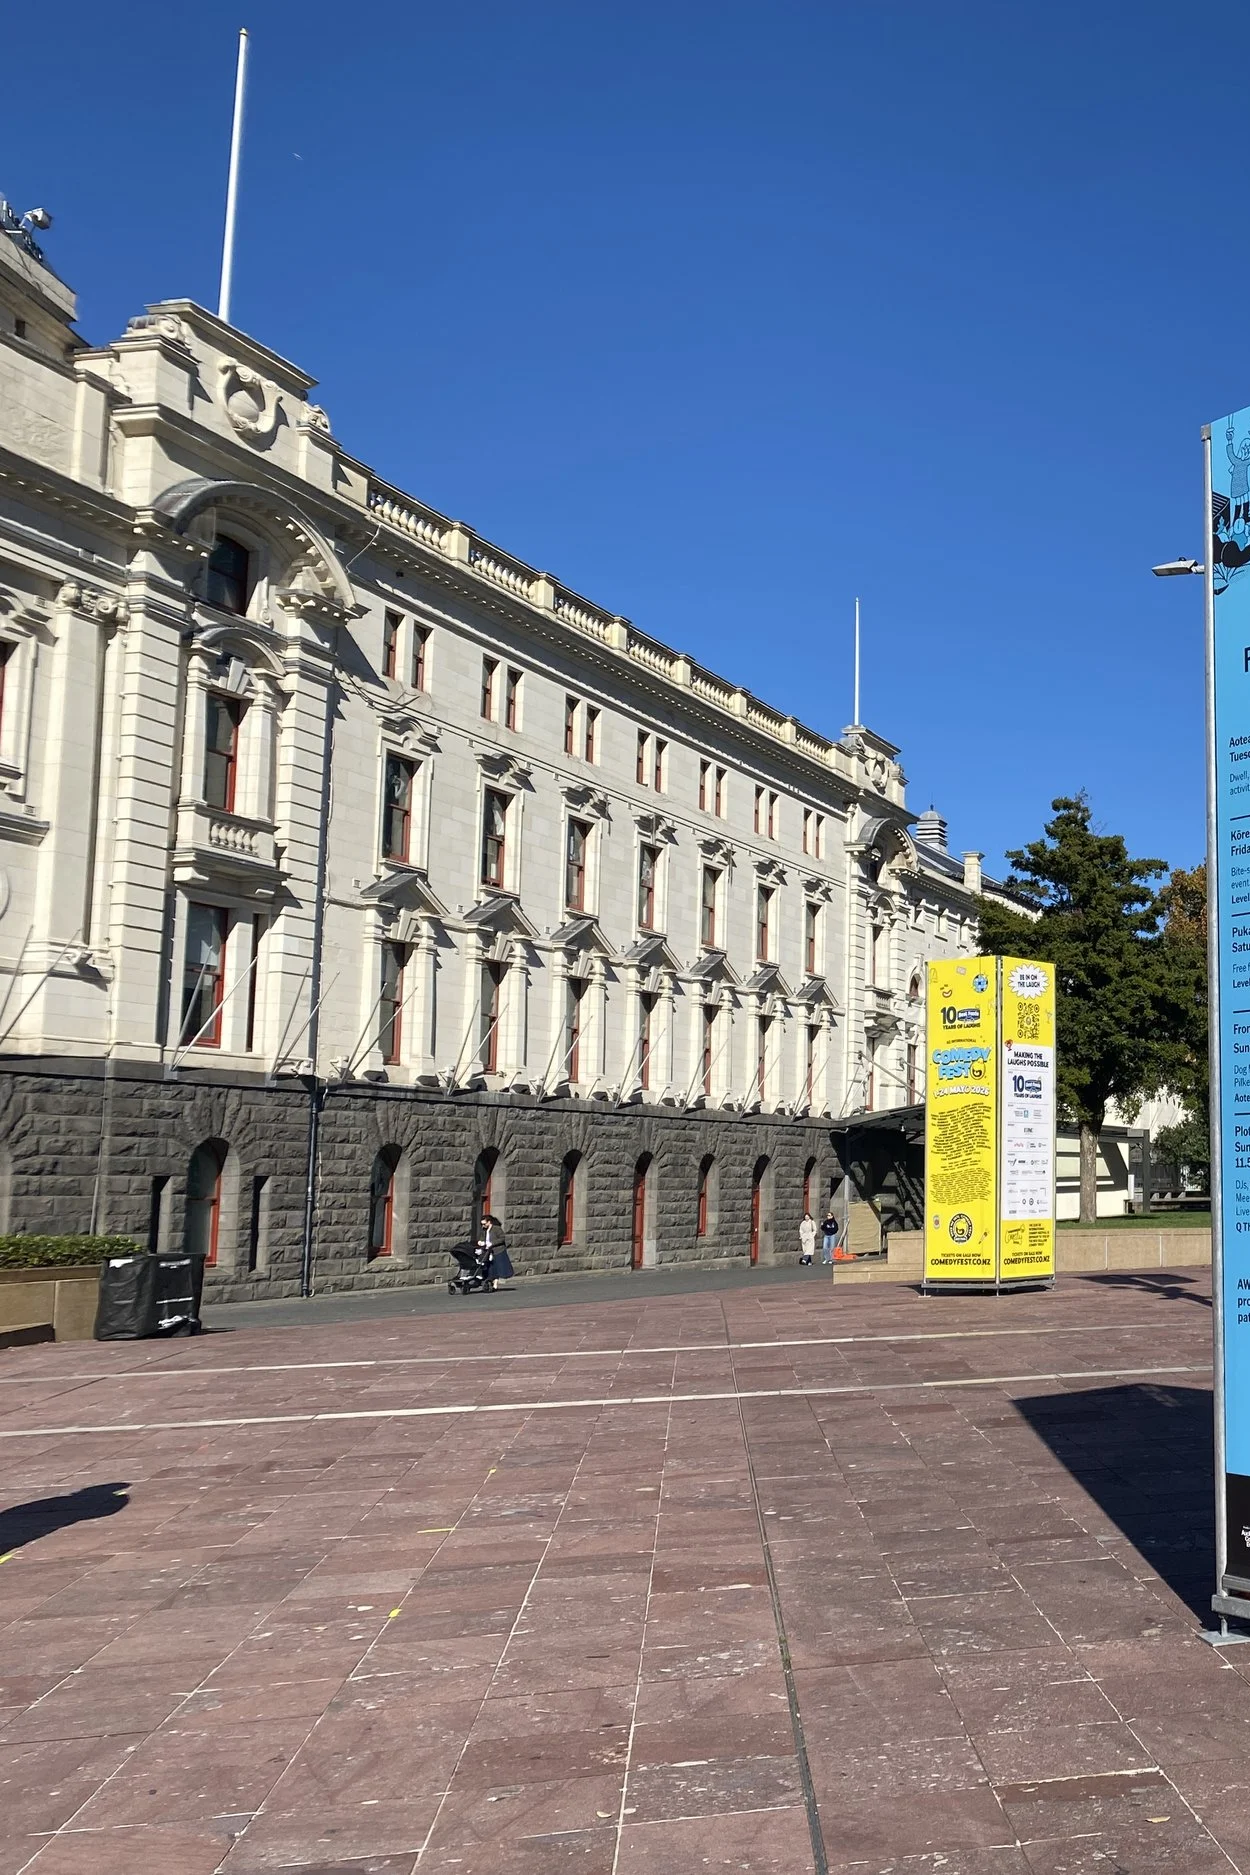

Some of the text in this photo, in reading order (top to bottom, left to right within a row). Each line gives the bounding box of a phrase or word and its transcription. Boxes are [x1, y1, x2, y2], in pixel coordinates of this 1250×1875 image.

[941, 1006, 956, 1024] 10
[932, 1046, 991, 1065] COMEDY
[1014, 1051, 1033, 1059] MAKING
[1008, 1058, 1048, 1068] LAUGHS POSSIBLE
[938, 1063, 970, 1080] FEST
[1013, 1075, 1024, 1092] 10
[1236, 1222, 1242, 1233] Q
[1004, 1256, 1050, 1265] COMEDYFEST.CO.NZ
